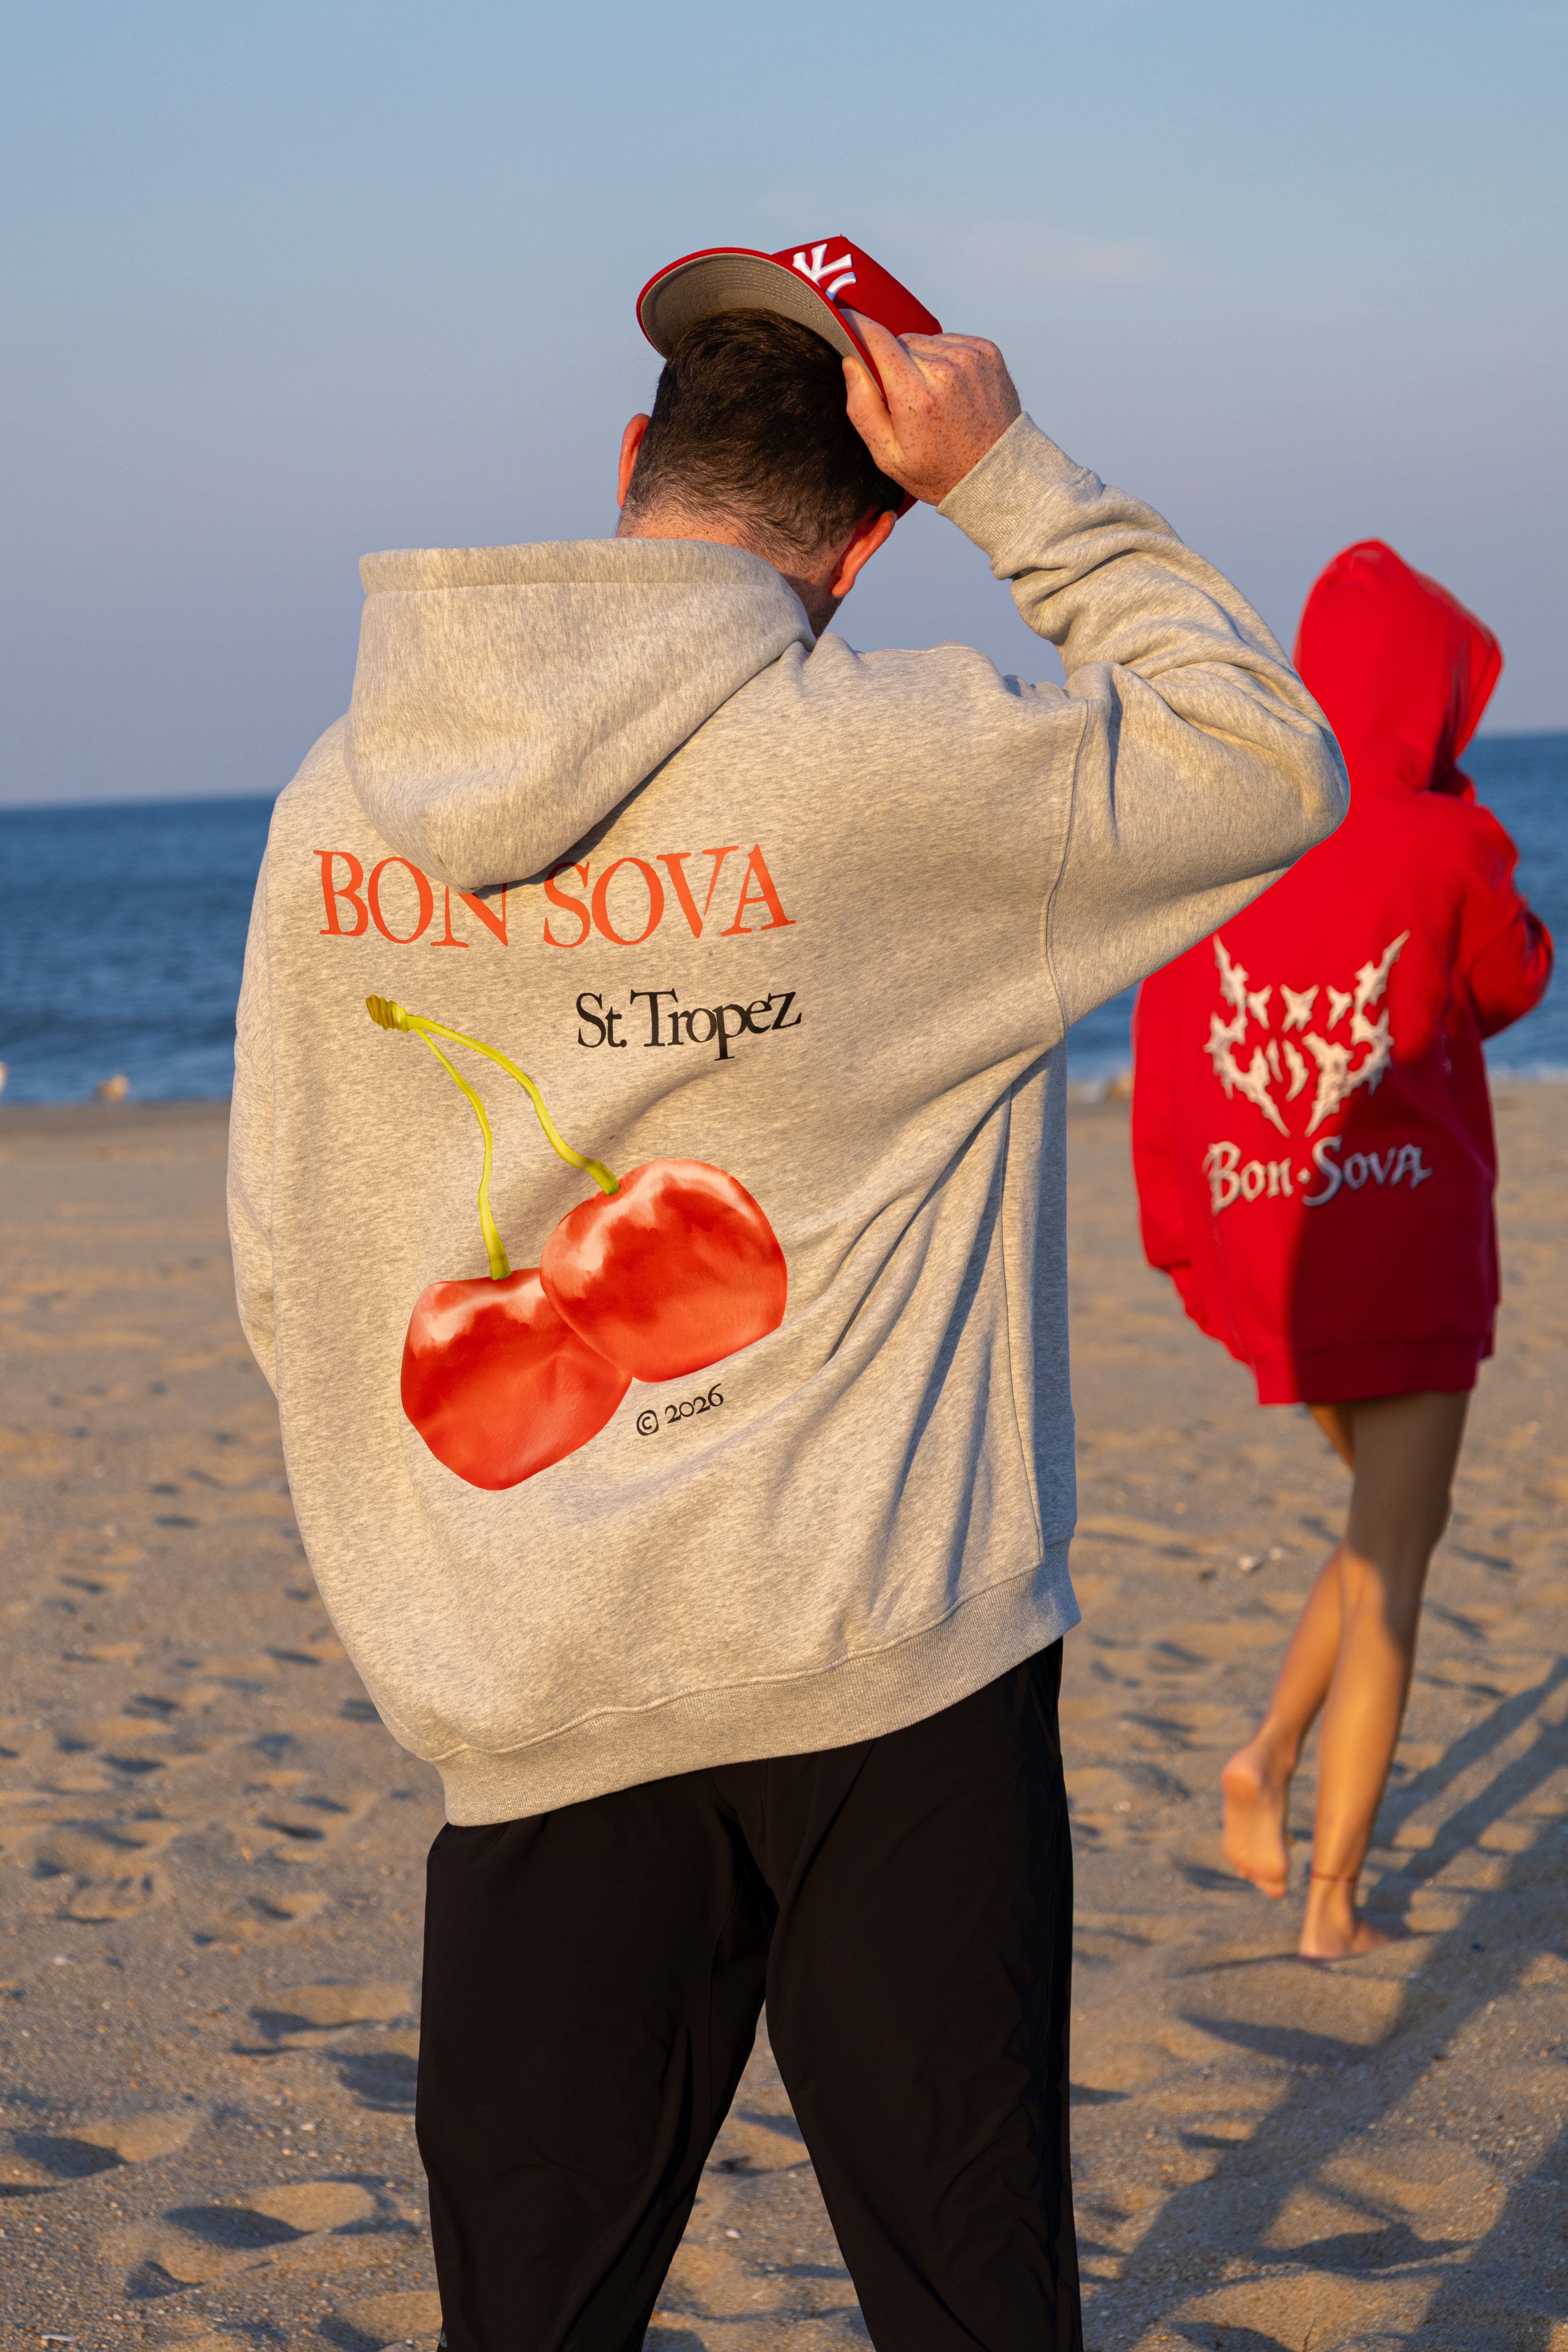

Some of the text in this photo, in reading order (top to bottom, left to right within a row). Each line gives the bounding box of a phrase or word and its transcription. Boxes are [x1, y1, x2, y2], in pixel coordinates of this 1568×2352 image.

[313, 843, 796, 948] BON SOVA
[630, 988, 802, 1061] Tropez
[665, 1383, 724, 1424] 2026
